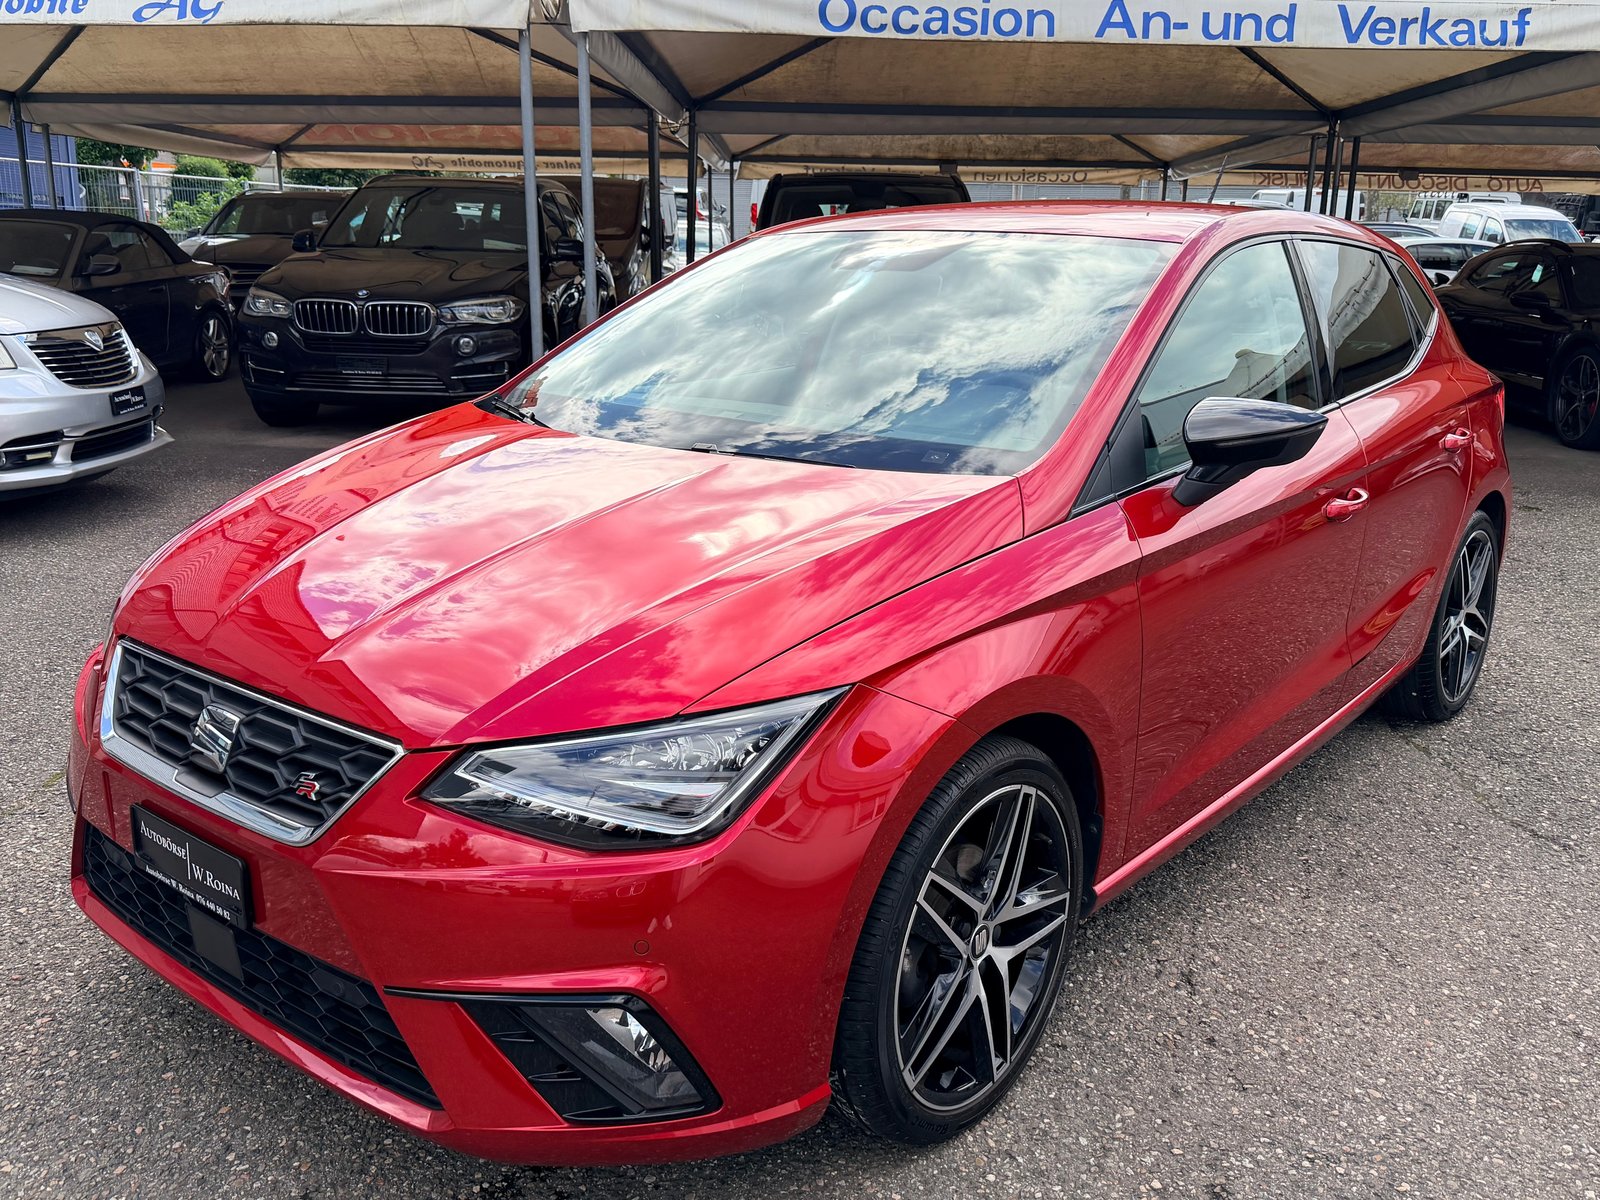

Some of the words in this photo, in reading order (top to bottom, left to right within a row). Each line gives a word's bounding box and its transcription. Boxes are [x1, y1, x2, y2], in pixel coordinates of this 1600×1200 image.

[0, 0, 88, 15] obile
[132, 0, 225, 24] AG
[818, 0, 1055, 38] Occasion
[1094, 0, 1188, 39] An-
[1201, 3, 1297, 43] und
[1337, 4, 1532, 47] Verkauf
